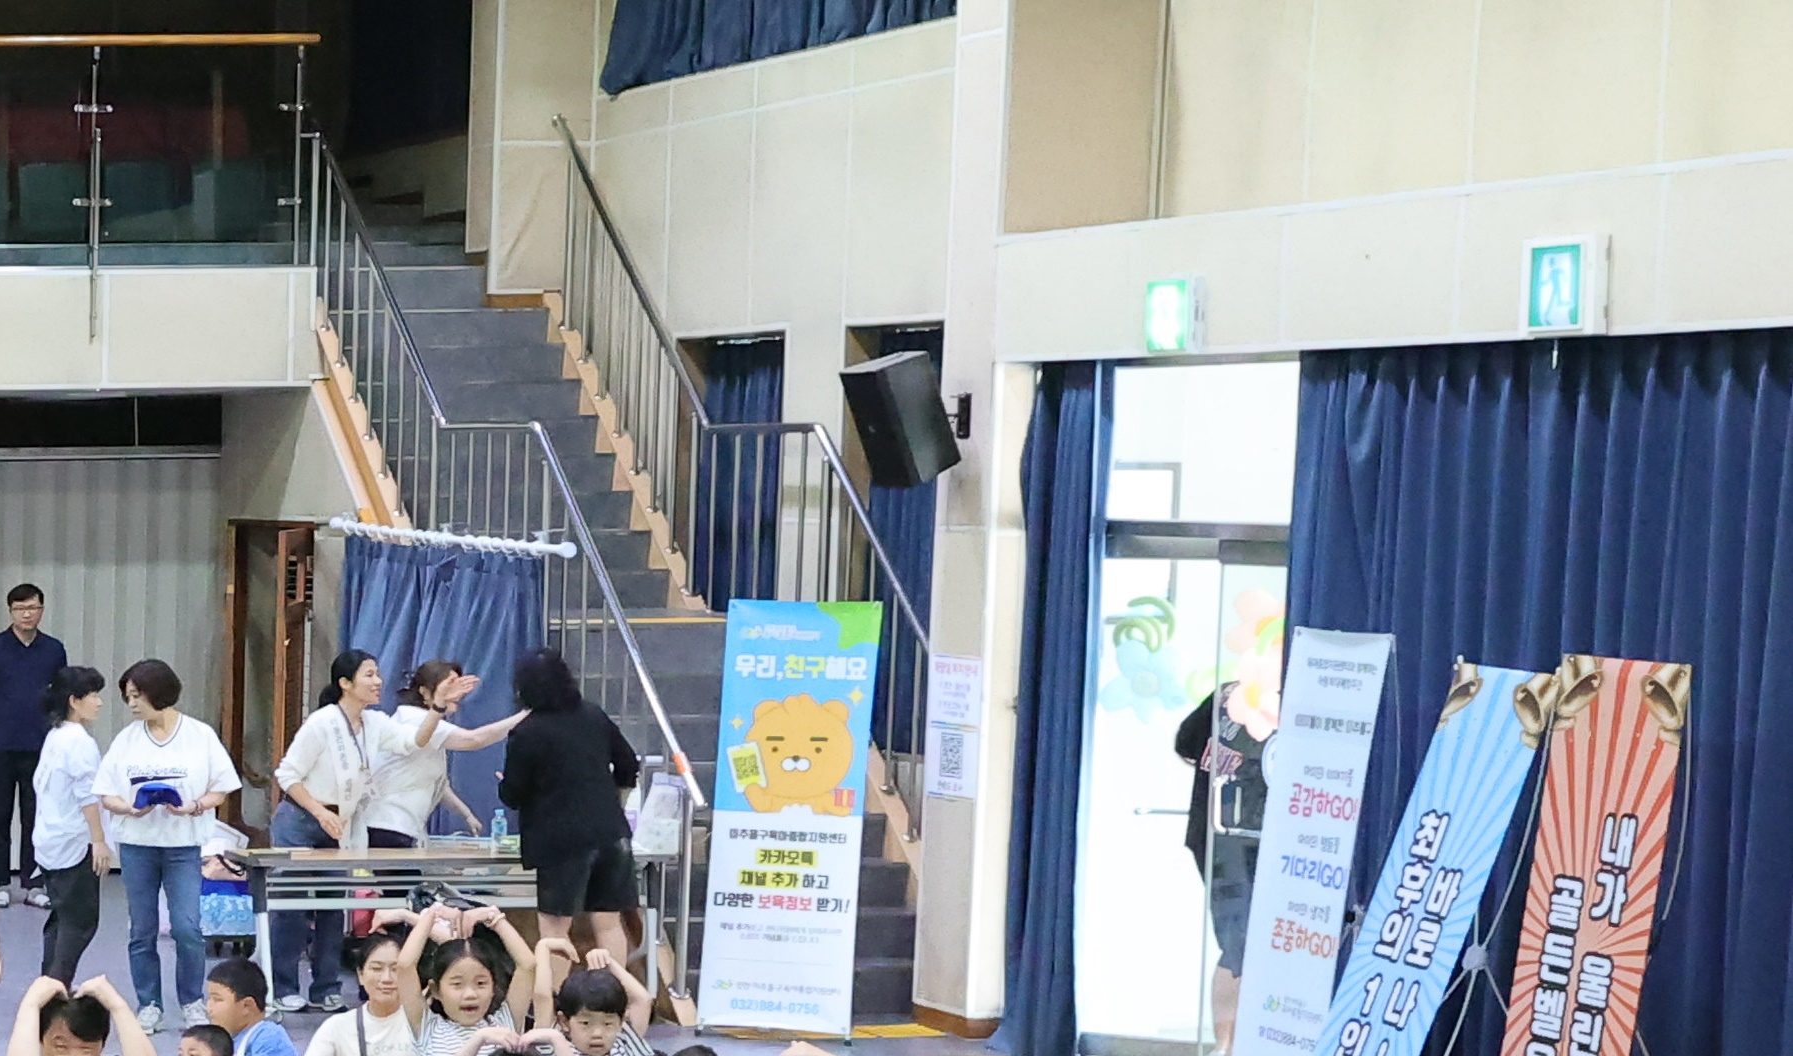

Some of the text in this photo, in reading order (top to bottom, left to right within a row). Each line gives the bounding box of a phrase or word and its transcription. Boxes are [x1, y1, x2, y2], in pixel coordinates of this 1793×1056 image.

[739, 870, 829, 889] 채널 추가 하고
[759, 849, 813, 866] 카카오톡
[1372, 809, 1451, 963] 최후의
[1589, 813, 1638, 927] 내가
[757, 894, 812, 911] 보육정보
[1403, 866, 1463, 970] 바로
